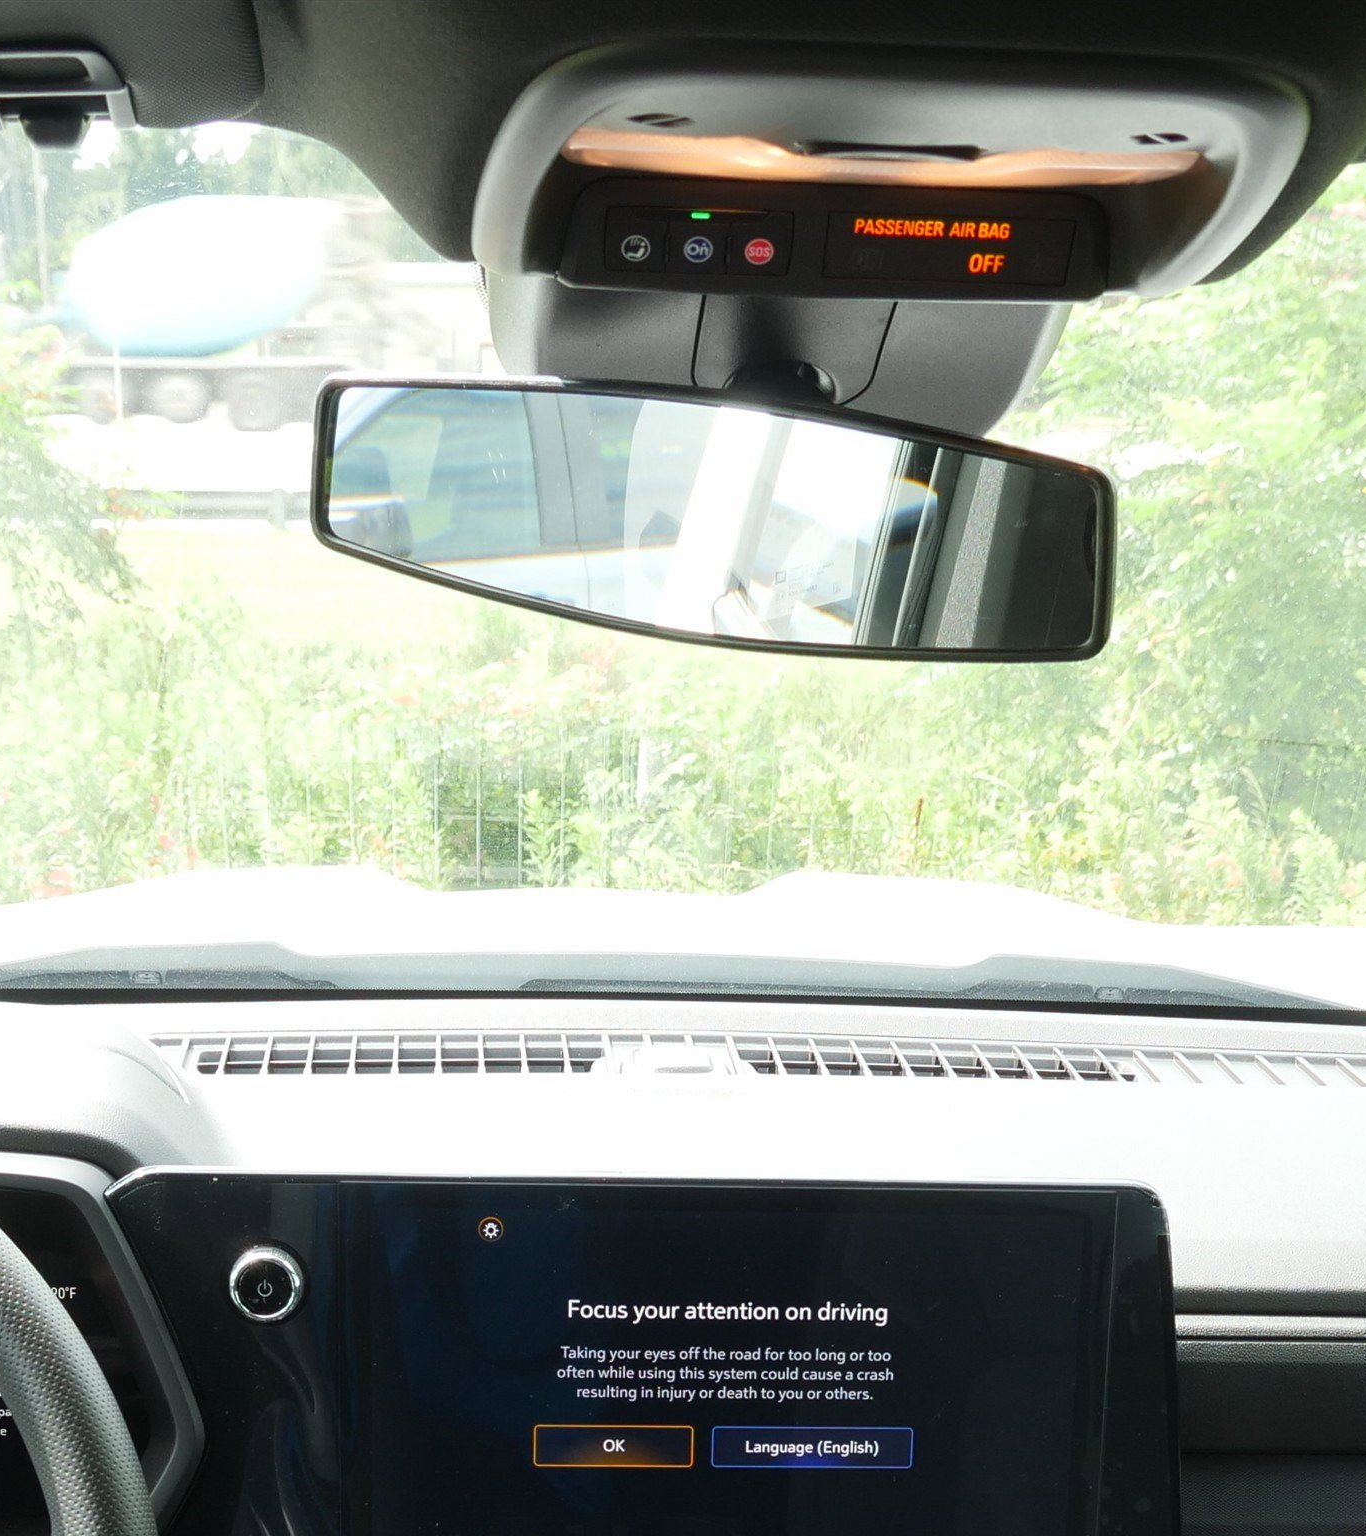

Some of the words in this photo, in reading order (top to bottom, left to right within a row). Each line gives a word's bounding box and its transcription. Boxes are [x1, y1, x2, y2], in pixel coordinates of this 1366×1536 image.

[854, 218, 944, 239] PASSENGER
[949, 221, 977, 240] AIR
[978, 222, 1011, 240] BAG
[747, 246, 772, 258] SOS
[968, 253, 1005, 275] OFF
[567, 1300, 628, 1320] Focus
[633, 1304, 677, 1324] your
[684, 1301, 779, 1321] attention
[785, 1305, 812, 1321] on
[817, 1302, 889, 1326] driving
[560, 1346, 606, 1363] Taking
[609, 1349, 641, 1363] your
[643, 1350, 676, 1363] eyes
[679, 1346, 701, 1361] off
[703, 1347, 726, 1361] the
[729, 1347, 761, 1362] road
[764, 1347, 785, 1362] for
[787, 1349, 812, 1362] too
[814, 1347, 847, 1365] long
[849, 1351, 865, 1363] or
[867, 1349, 892, 1363] too
[556, 1365, 596, 1380] often
[598, 1365, 635, 1381] while
[638, 1367, 676, 1383] using
[679, 1366, 706, 1381] this
[708, 1368, 758, 1384] system
[760, 1366, 799, 1382] could
[802, 1370, 843, 1382] cause
[845, 1371, 854, 1382] a
[856, 1367, 895, 1382] crash
[576, 1385, 638, 1403] resulting
[640, 1386, 654, 1400] in
[656, 1386, 696, 1403] injury
[698, 1390, 714, 1401] or
[717, 1387, 758, 1401] death
[760, 1388, 776, 1401] to
[778, 1389, 805, 1403] you
[807, 1391, 823, 1402] or
[824, 1387, 875, 1402] others.
[603, 1439, 626, 1453] OK
[745, 1441, 814, 1457] Language
[817, 1440, 880, 1457] (English)
